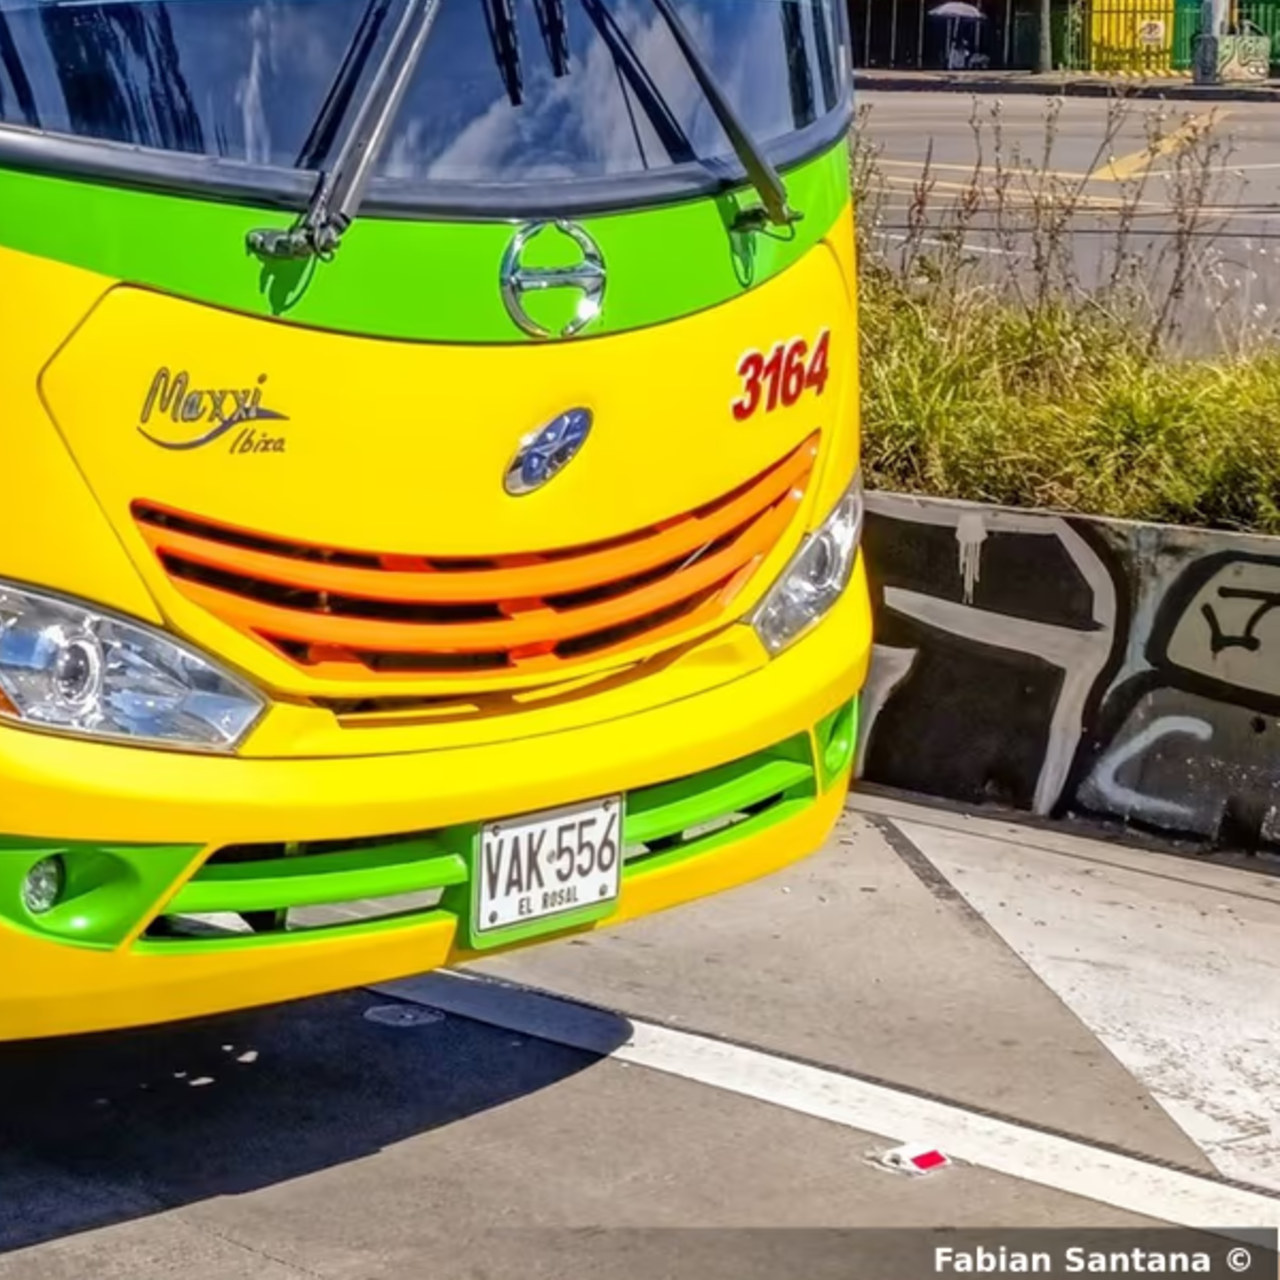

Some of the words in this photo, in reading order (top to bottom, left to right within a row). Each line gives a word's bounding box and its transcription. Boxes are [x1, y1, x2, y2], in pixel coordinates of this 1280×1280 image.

[139, 366, 269, 424] Maxxi
[729, 325, 831, 423] 3164
[517, 897, 533, 916] EL
[540, 886, 579, 910] ROSAL
